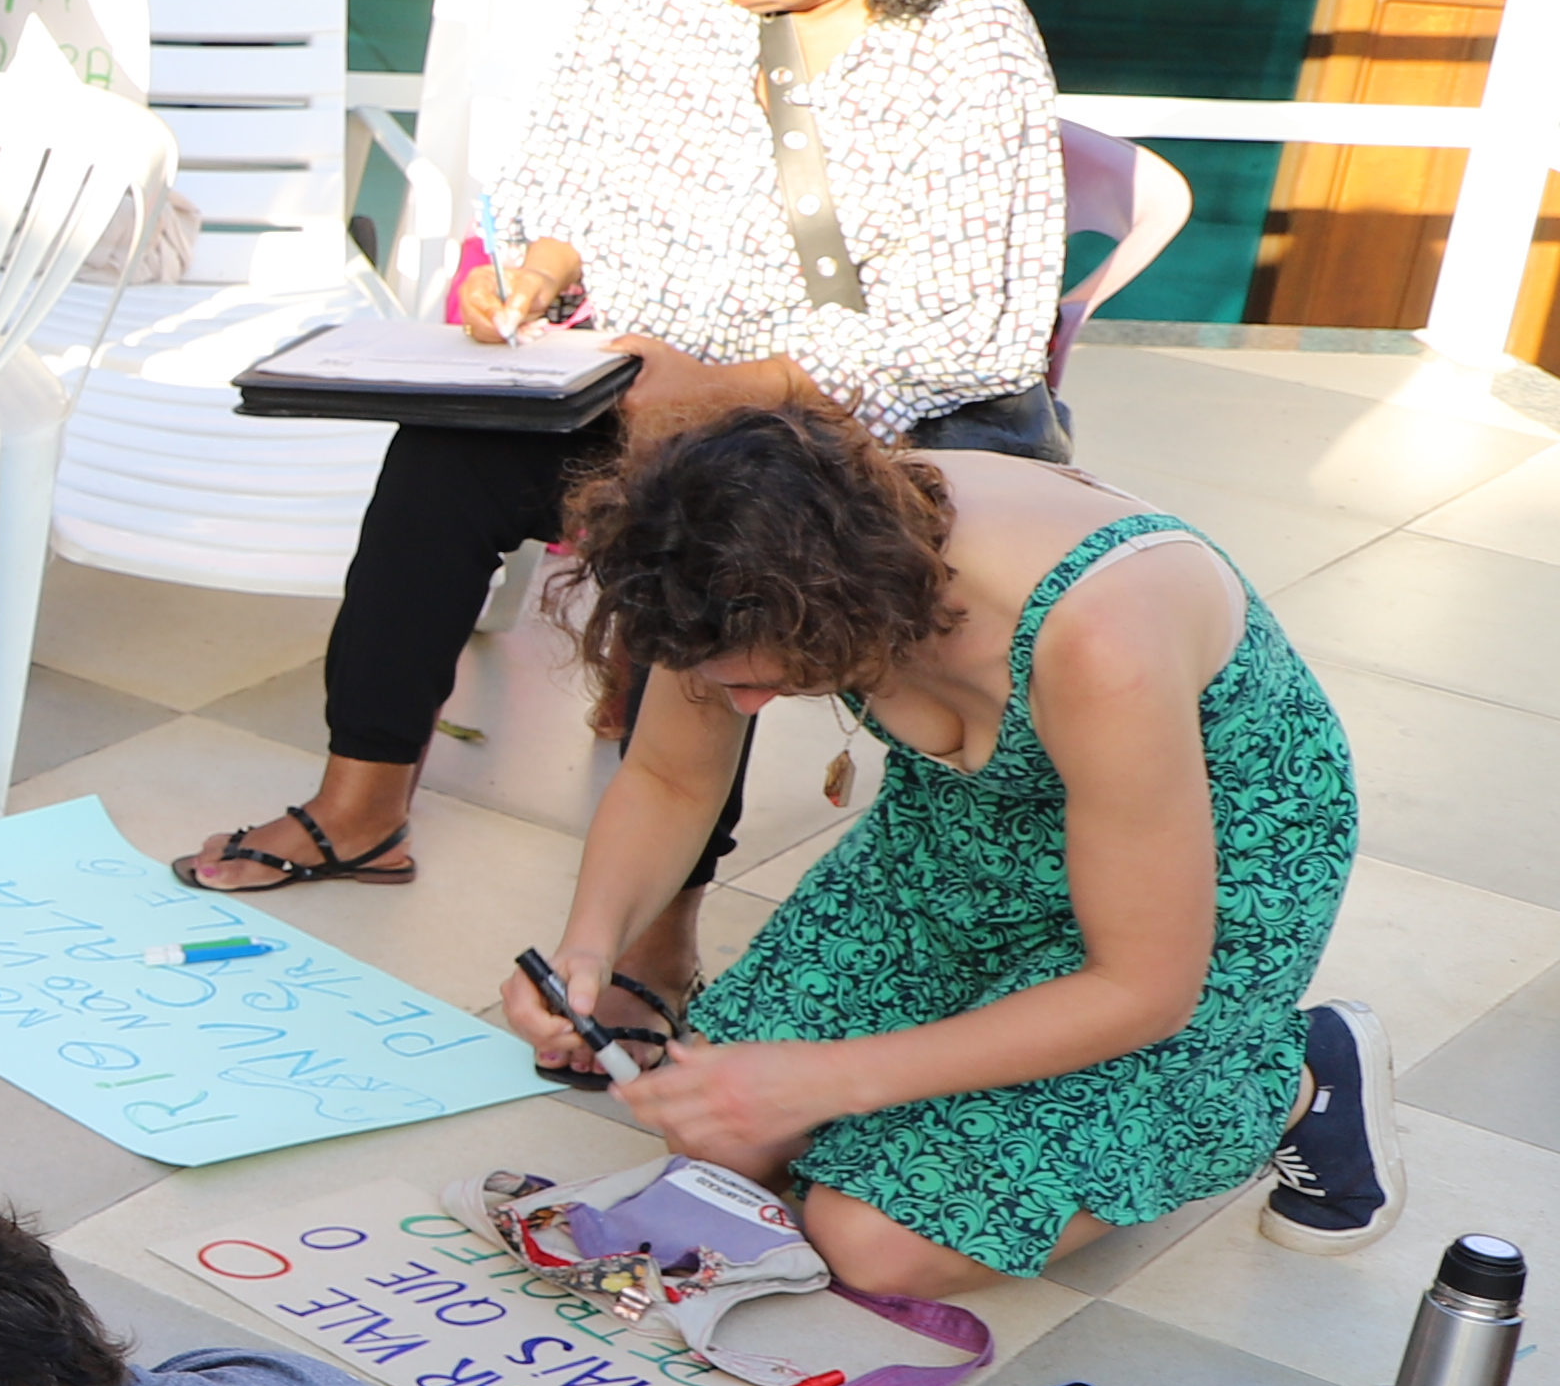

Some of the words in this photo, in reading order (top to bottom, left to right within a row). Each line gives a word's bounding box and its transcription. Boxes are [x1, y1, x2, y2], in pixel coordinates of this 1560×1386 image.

[299, 1226, 367, 1250] O
[277, 1287, 430, 1364] VALE
[365, 1261, 507, 1326] QUE
